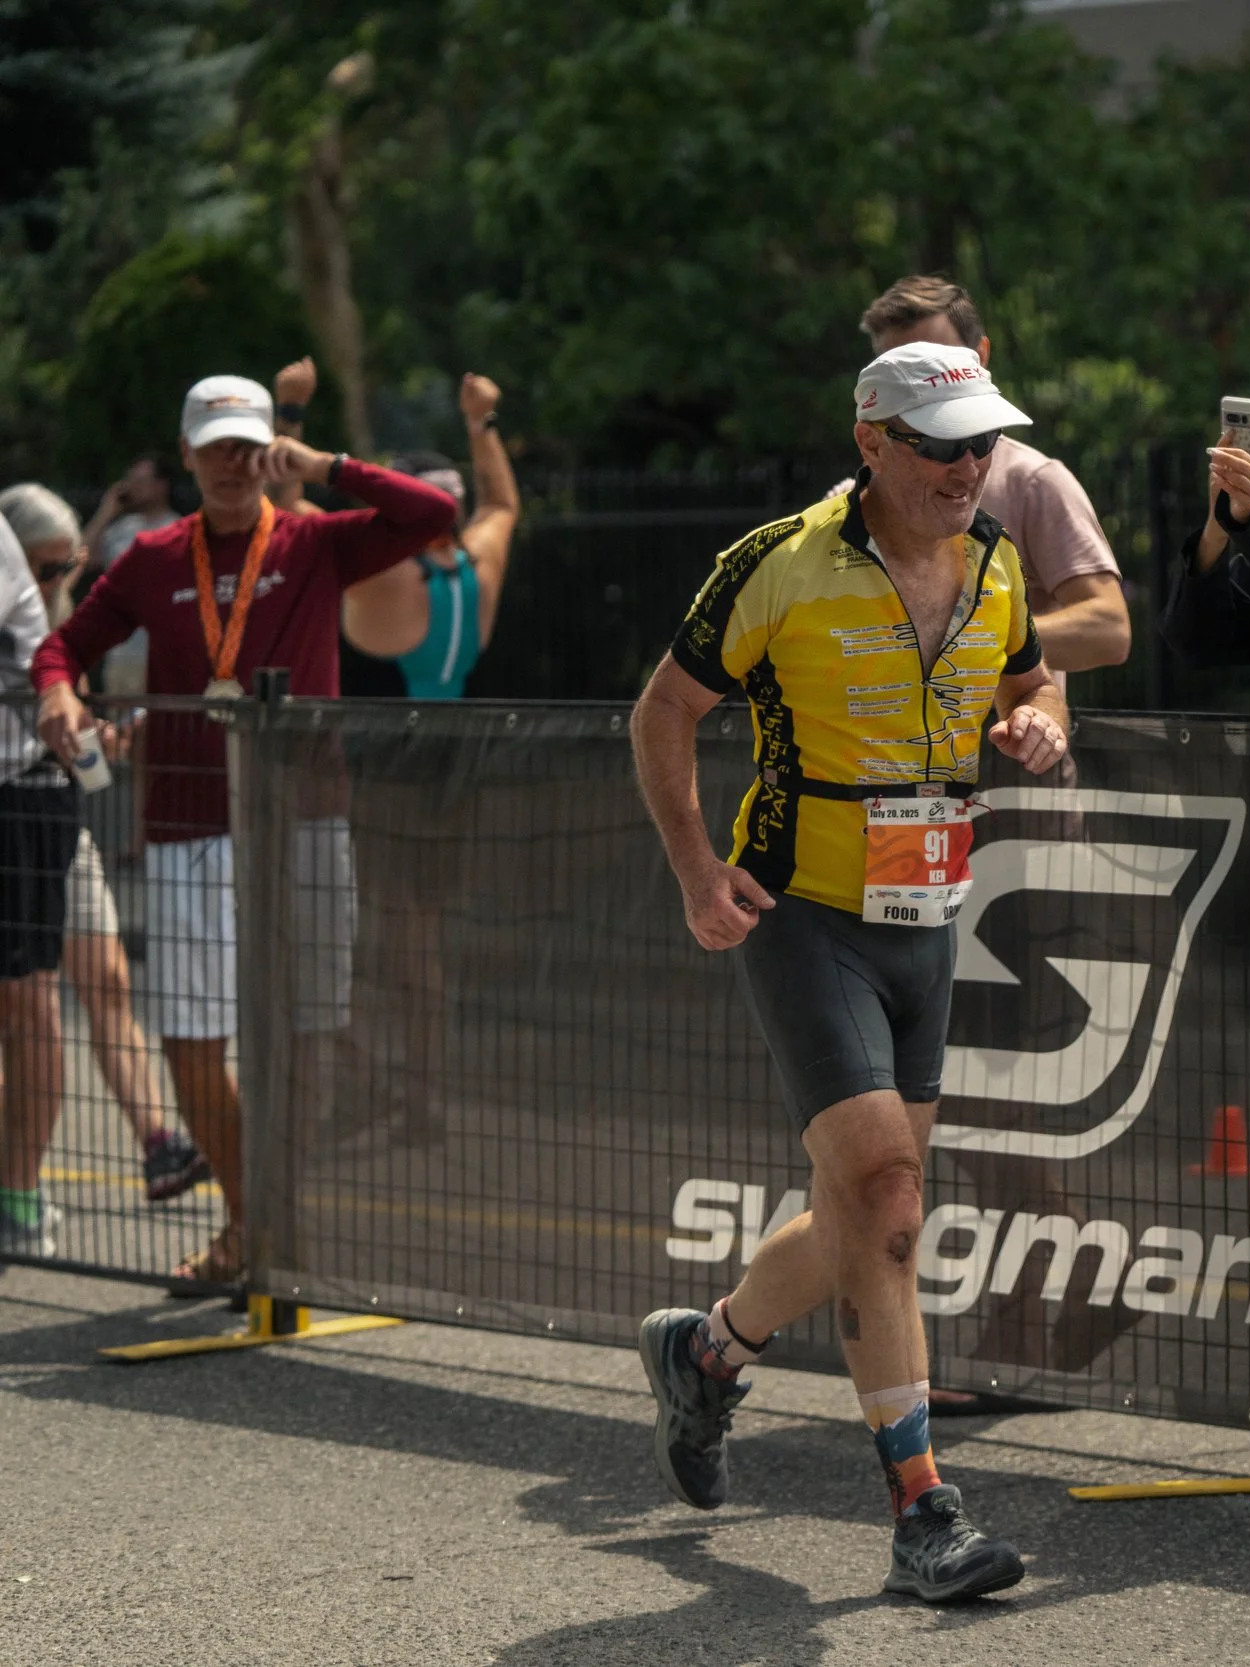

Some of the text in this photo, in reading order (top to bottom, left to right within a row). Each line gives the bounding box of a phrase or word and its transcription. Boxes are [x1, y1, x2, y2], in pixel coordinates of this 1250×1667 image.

[923, 367, 986, 388] TIMEX
[869, 809, 920, 819] July 20, 2025
[924, 830, 949, 863] 91
[928, 870, 946, 884] KEN
[884, 906, 919, 921] FOOD
